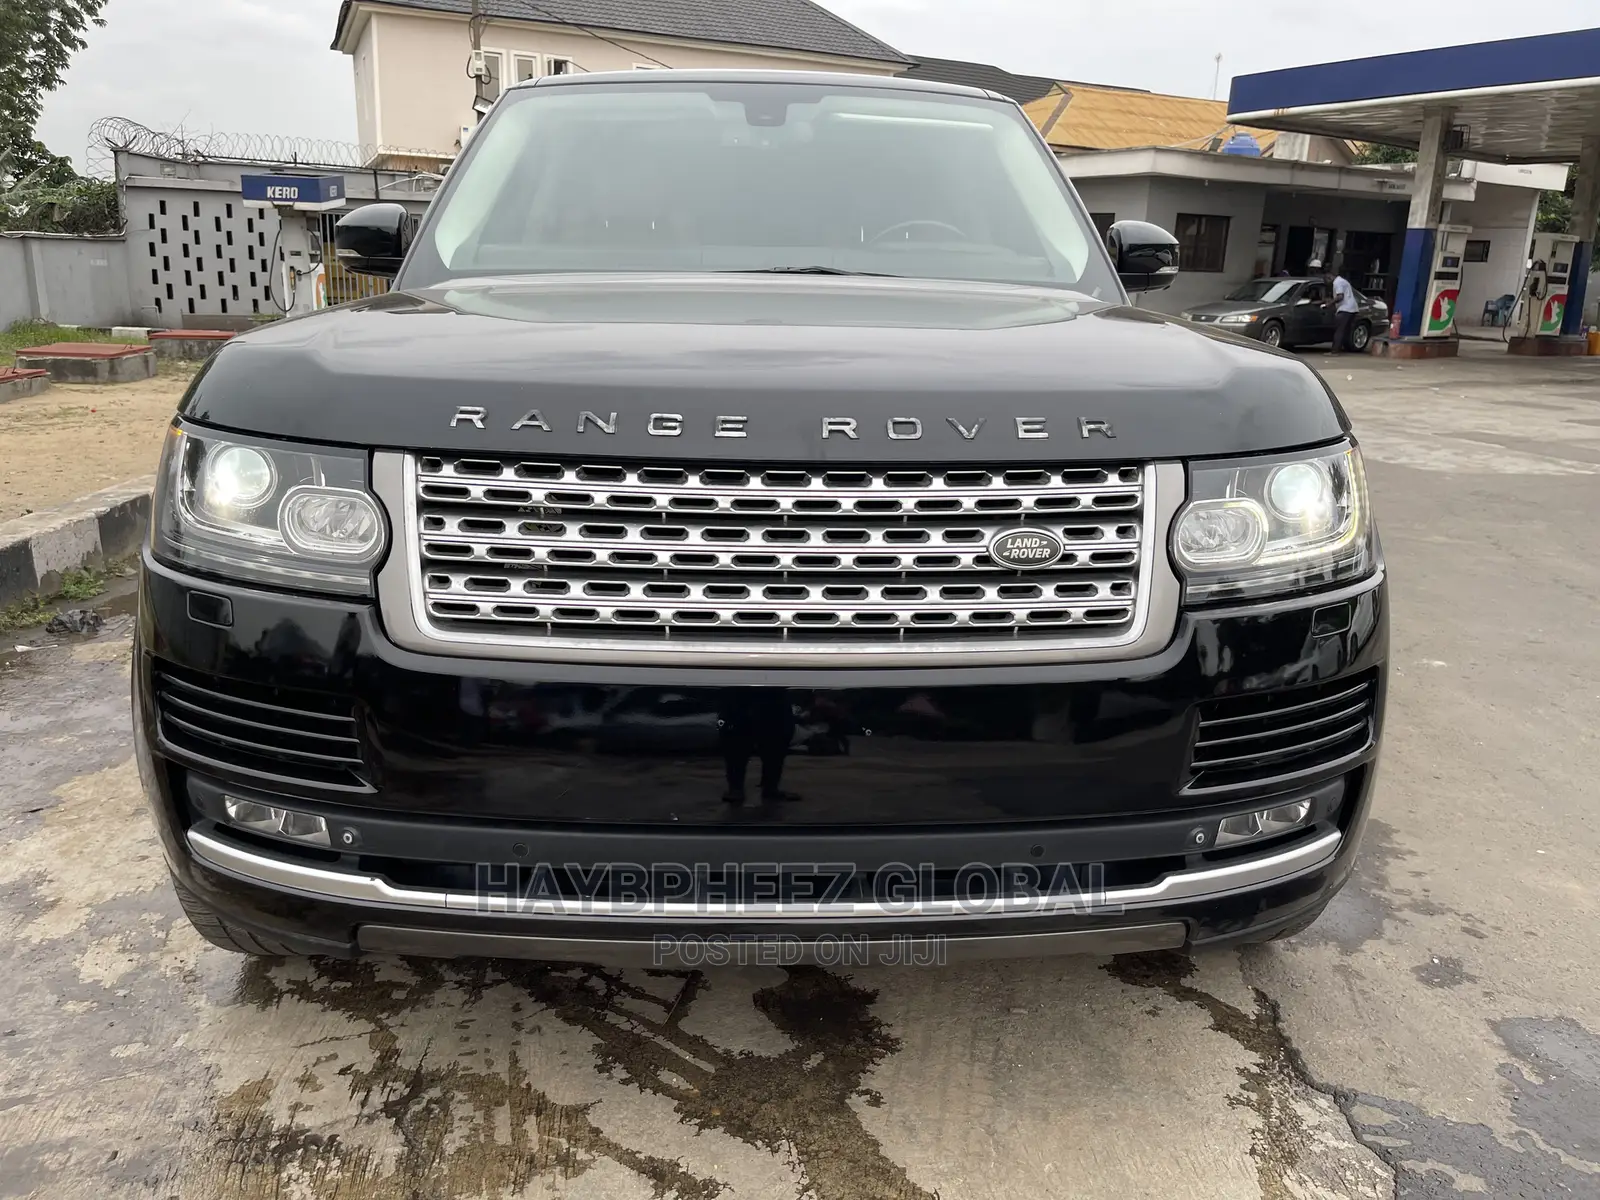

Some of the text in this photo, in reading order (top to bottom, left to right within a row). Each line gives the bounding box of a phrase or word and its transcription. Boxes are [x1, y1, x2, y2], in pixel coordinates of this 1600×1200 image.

[266, 186, 298, 199] KERO
[450, 405, 1117, 440] RANGE ROVER
[1006, 538, 1040, 549] LAND
[1010, 548, 1051, 559] ROVER
